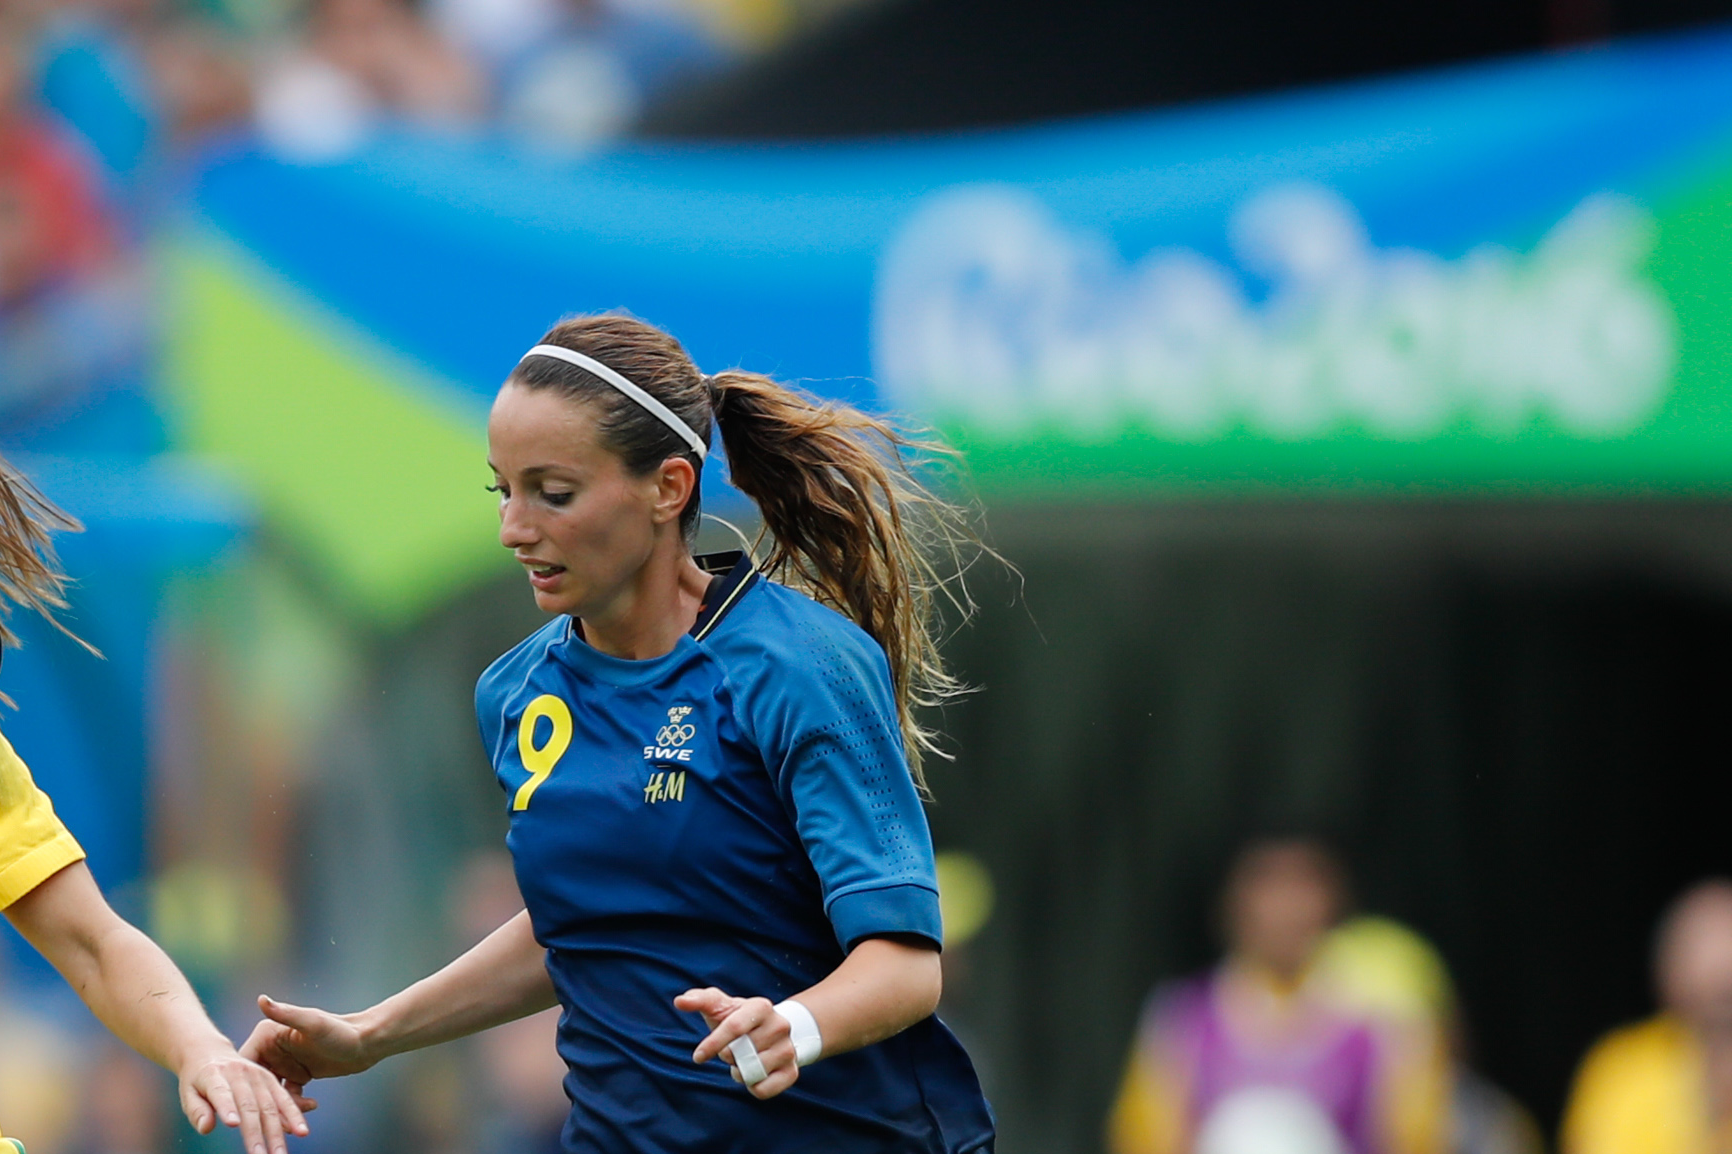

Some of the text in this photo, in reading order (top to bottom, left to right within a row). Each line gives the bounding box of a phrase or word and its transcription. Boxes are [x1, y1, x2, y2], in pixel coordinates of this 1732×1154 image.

[512, 693, 573, 812] 9
[643, 745, 694, 761] SWE
[643, 770, 686, 804] H&M
